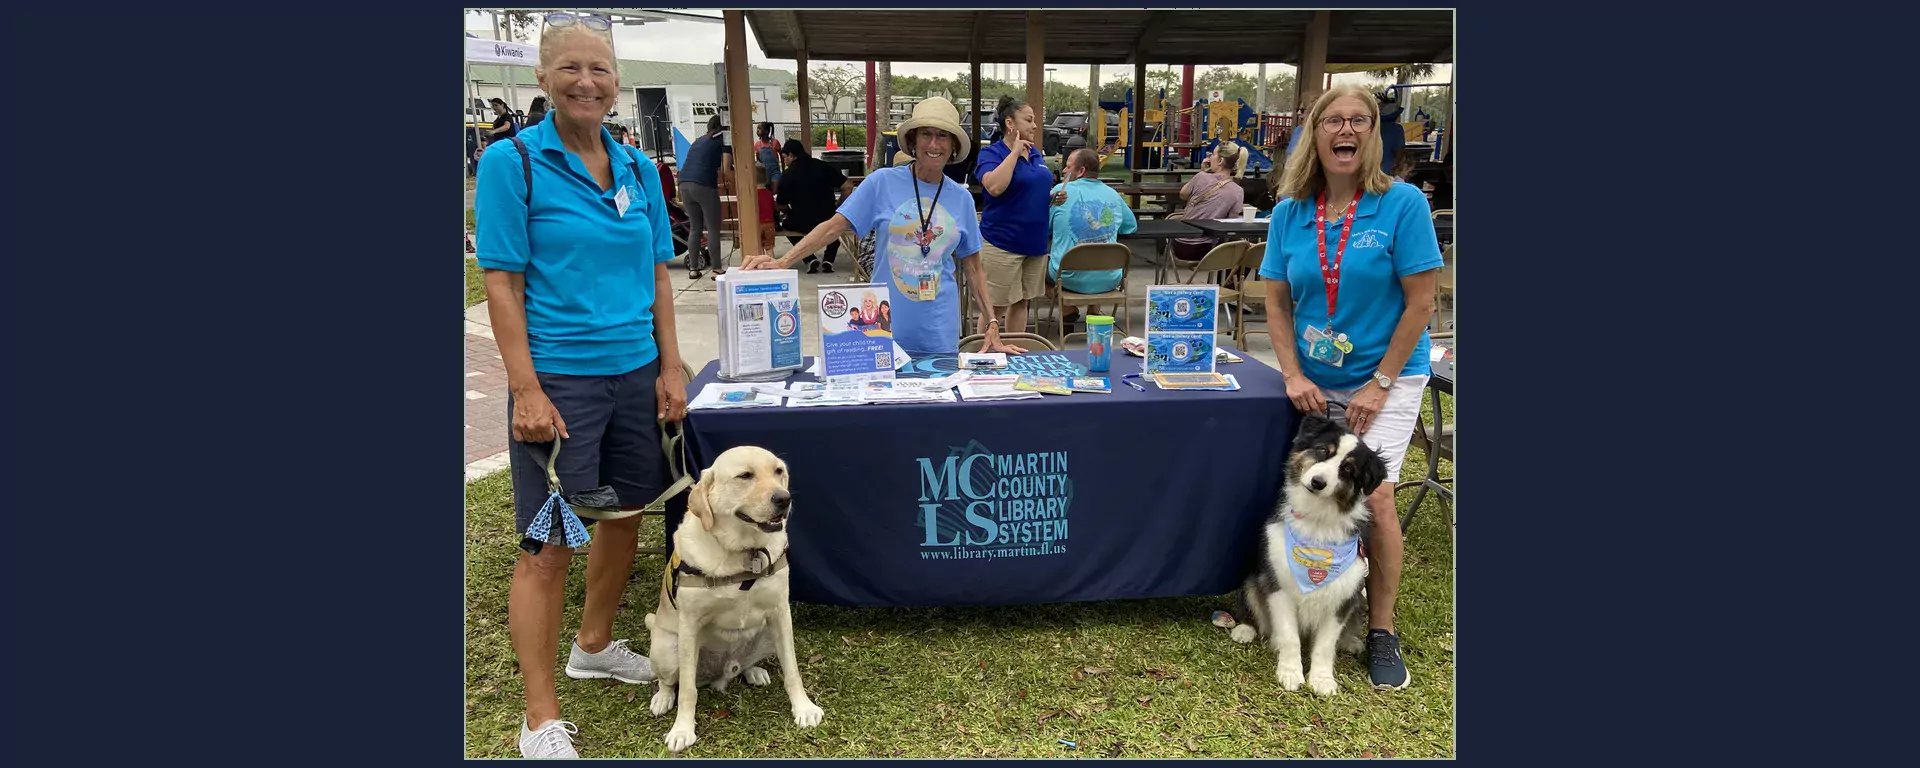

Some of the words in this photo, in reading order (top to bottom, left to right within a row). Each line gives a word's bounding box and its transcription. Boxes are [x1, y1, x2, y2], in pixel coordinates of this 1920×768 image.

[500, 45, 524, 58] Kiwanis
[998, 451, 1068, 476] MARTIN
[916, 453, 996, 502] MC
[998, 474, 1068, 499] COUNTY
[998, 497, 1068, 521] LIBRARY
[918, 500, 999, 547] LS
[998, 519, 1069, 544] SYSTEM
[920, 542, 1067, 562] www.library.martin.fl.us
